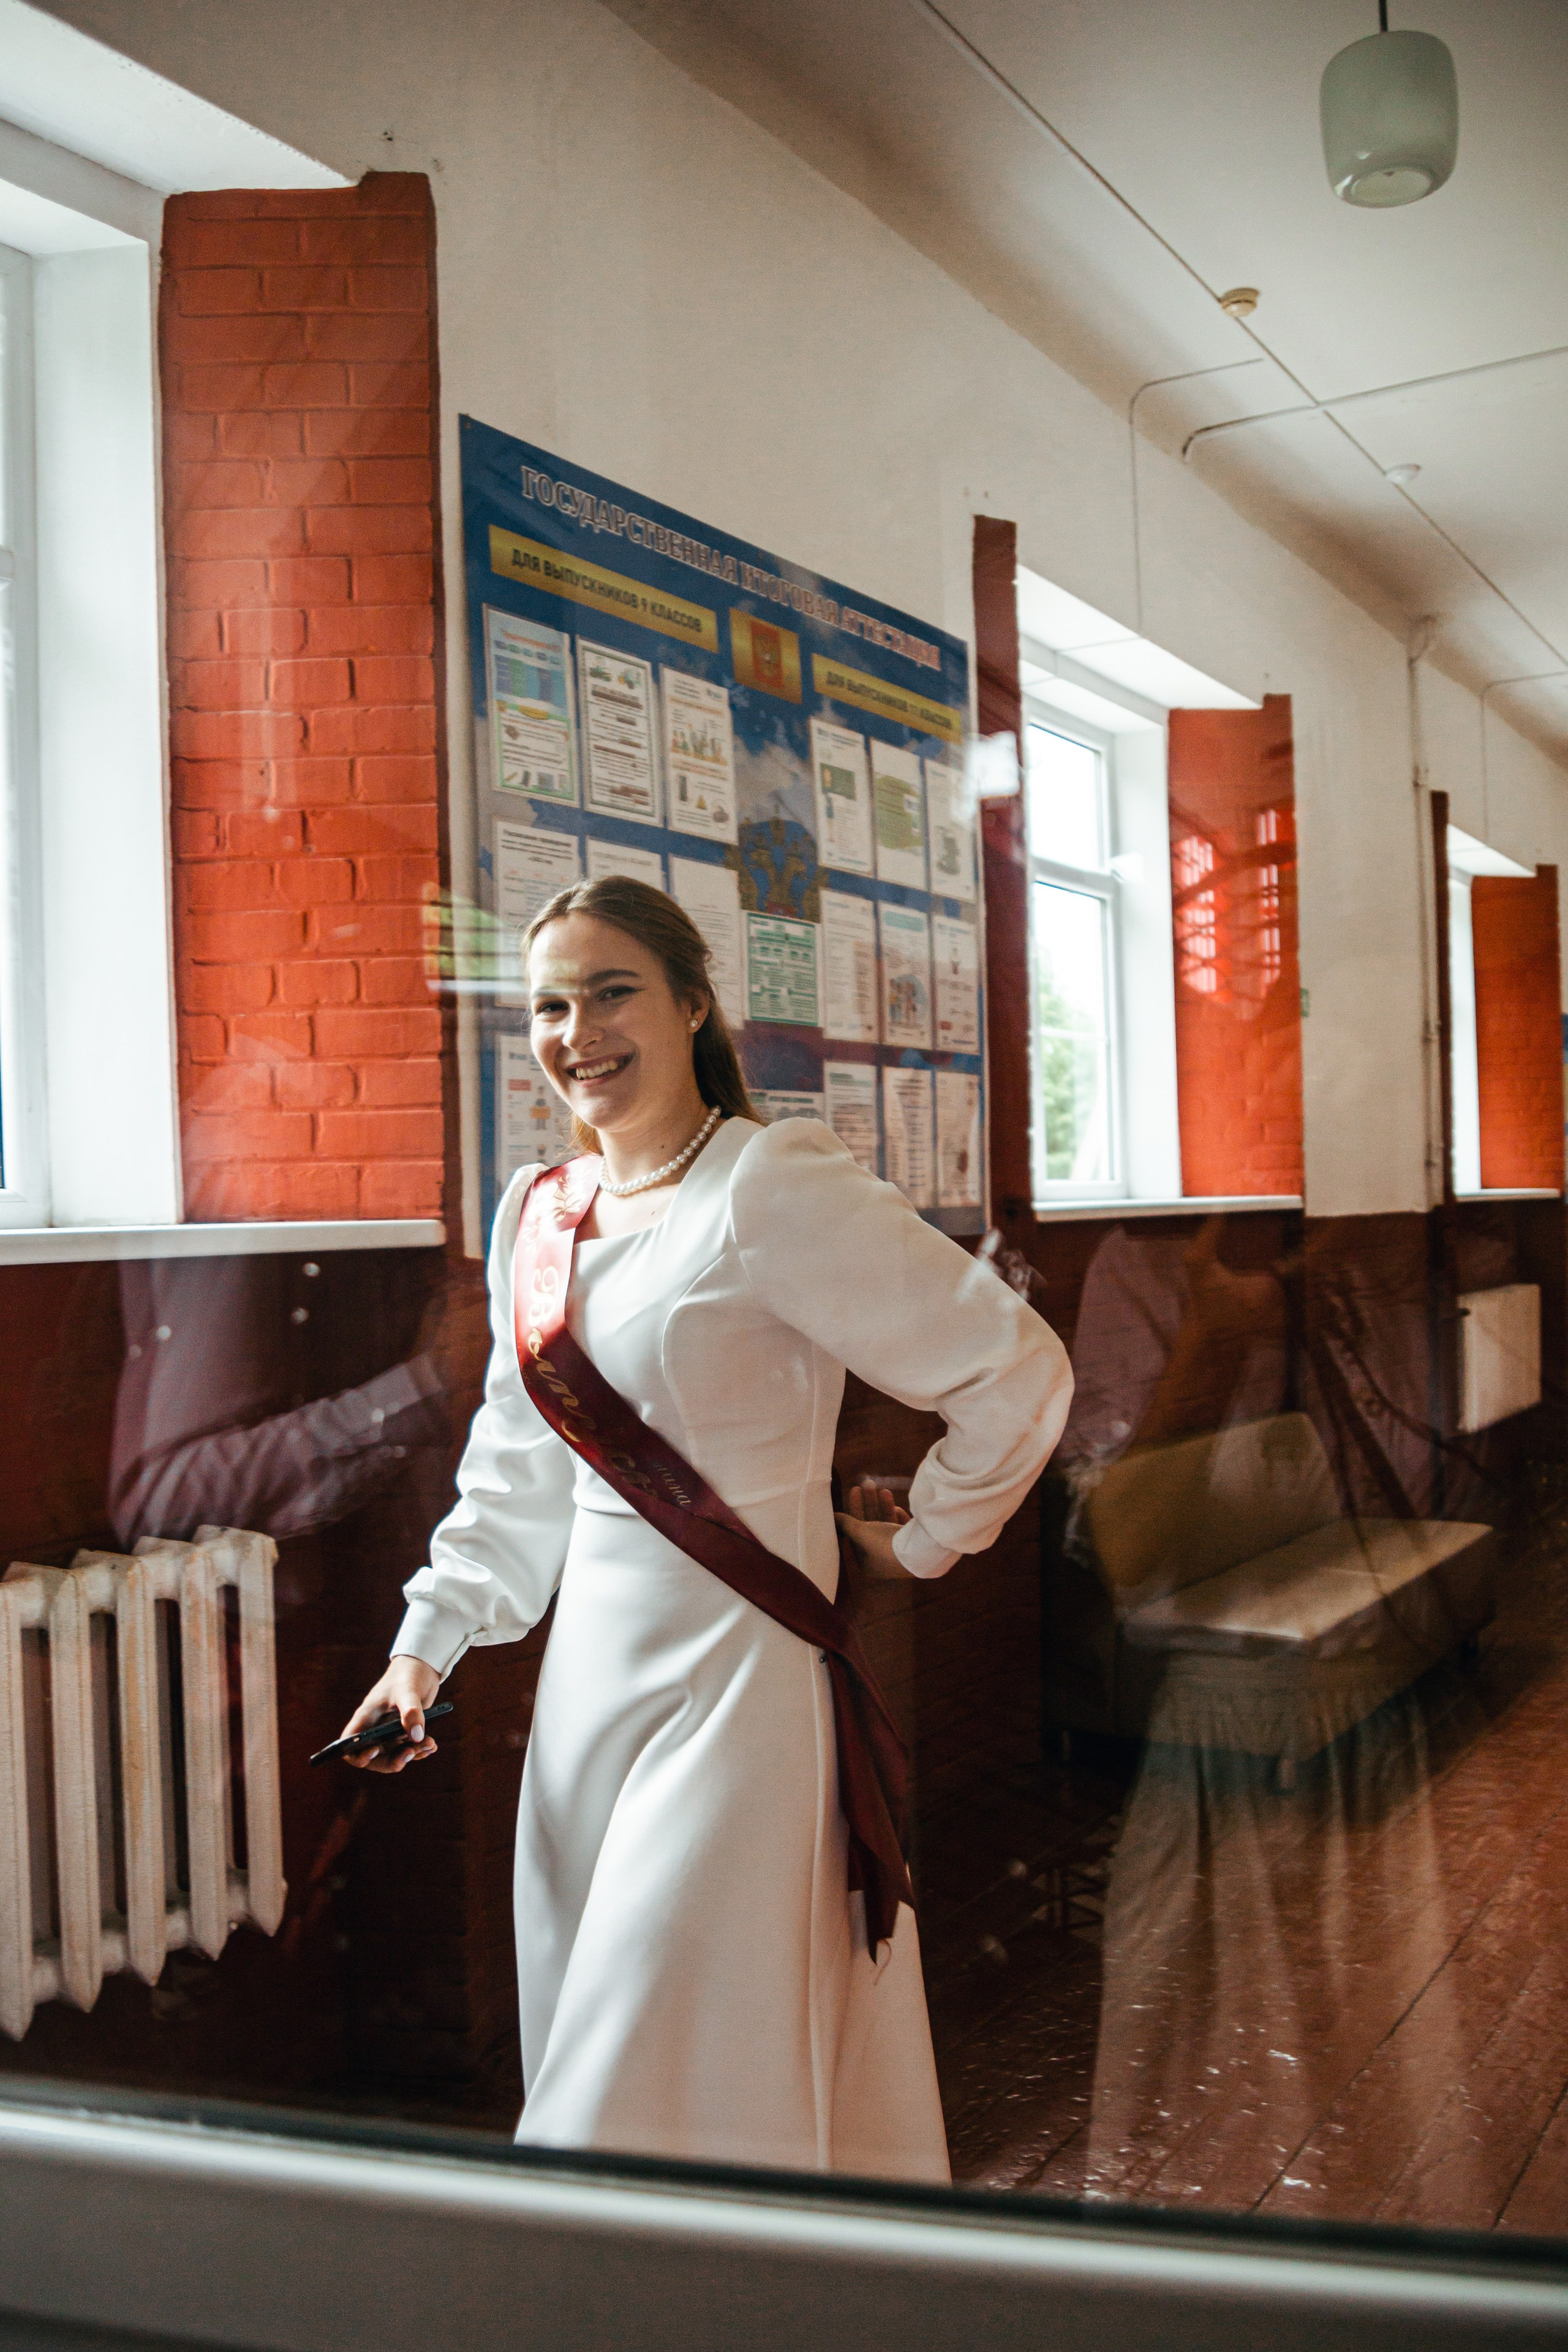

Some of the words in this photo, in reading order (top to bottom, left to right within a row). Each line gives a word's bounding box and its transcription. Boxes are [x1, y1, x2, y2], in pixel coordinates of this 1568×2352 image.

[512, 548, 540, 573] ДЛЯ
[544, 559, 638, 609] ВЫПУСКНИКОВ
[650, 601, 703, 633] КЛАССОВ
[521, 466, 739, 586] ГОСУДАРСТВЕННАЯ
[739, 561, 840, 628] ИТОГОВАЯ
